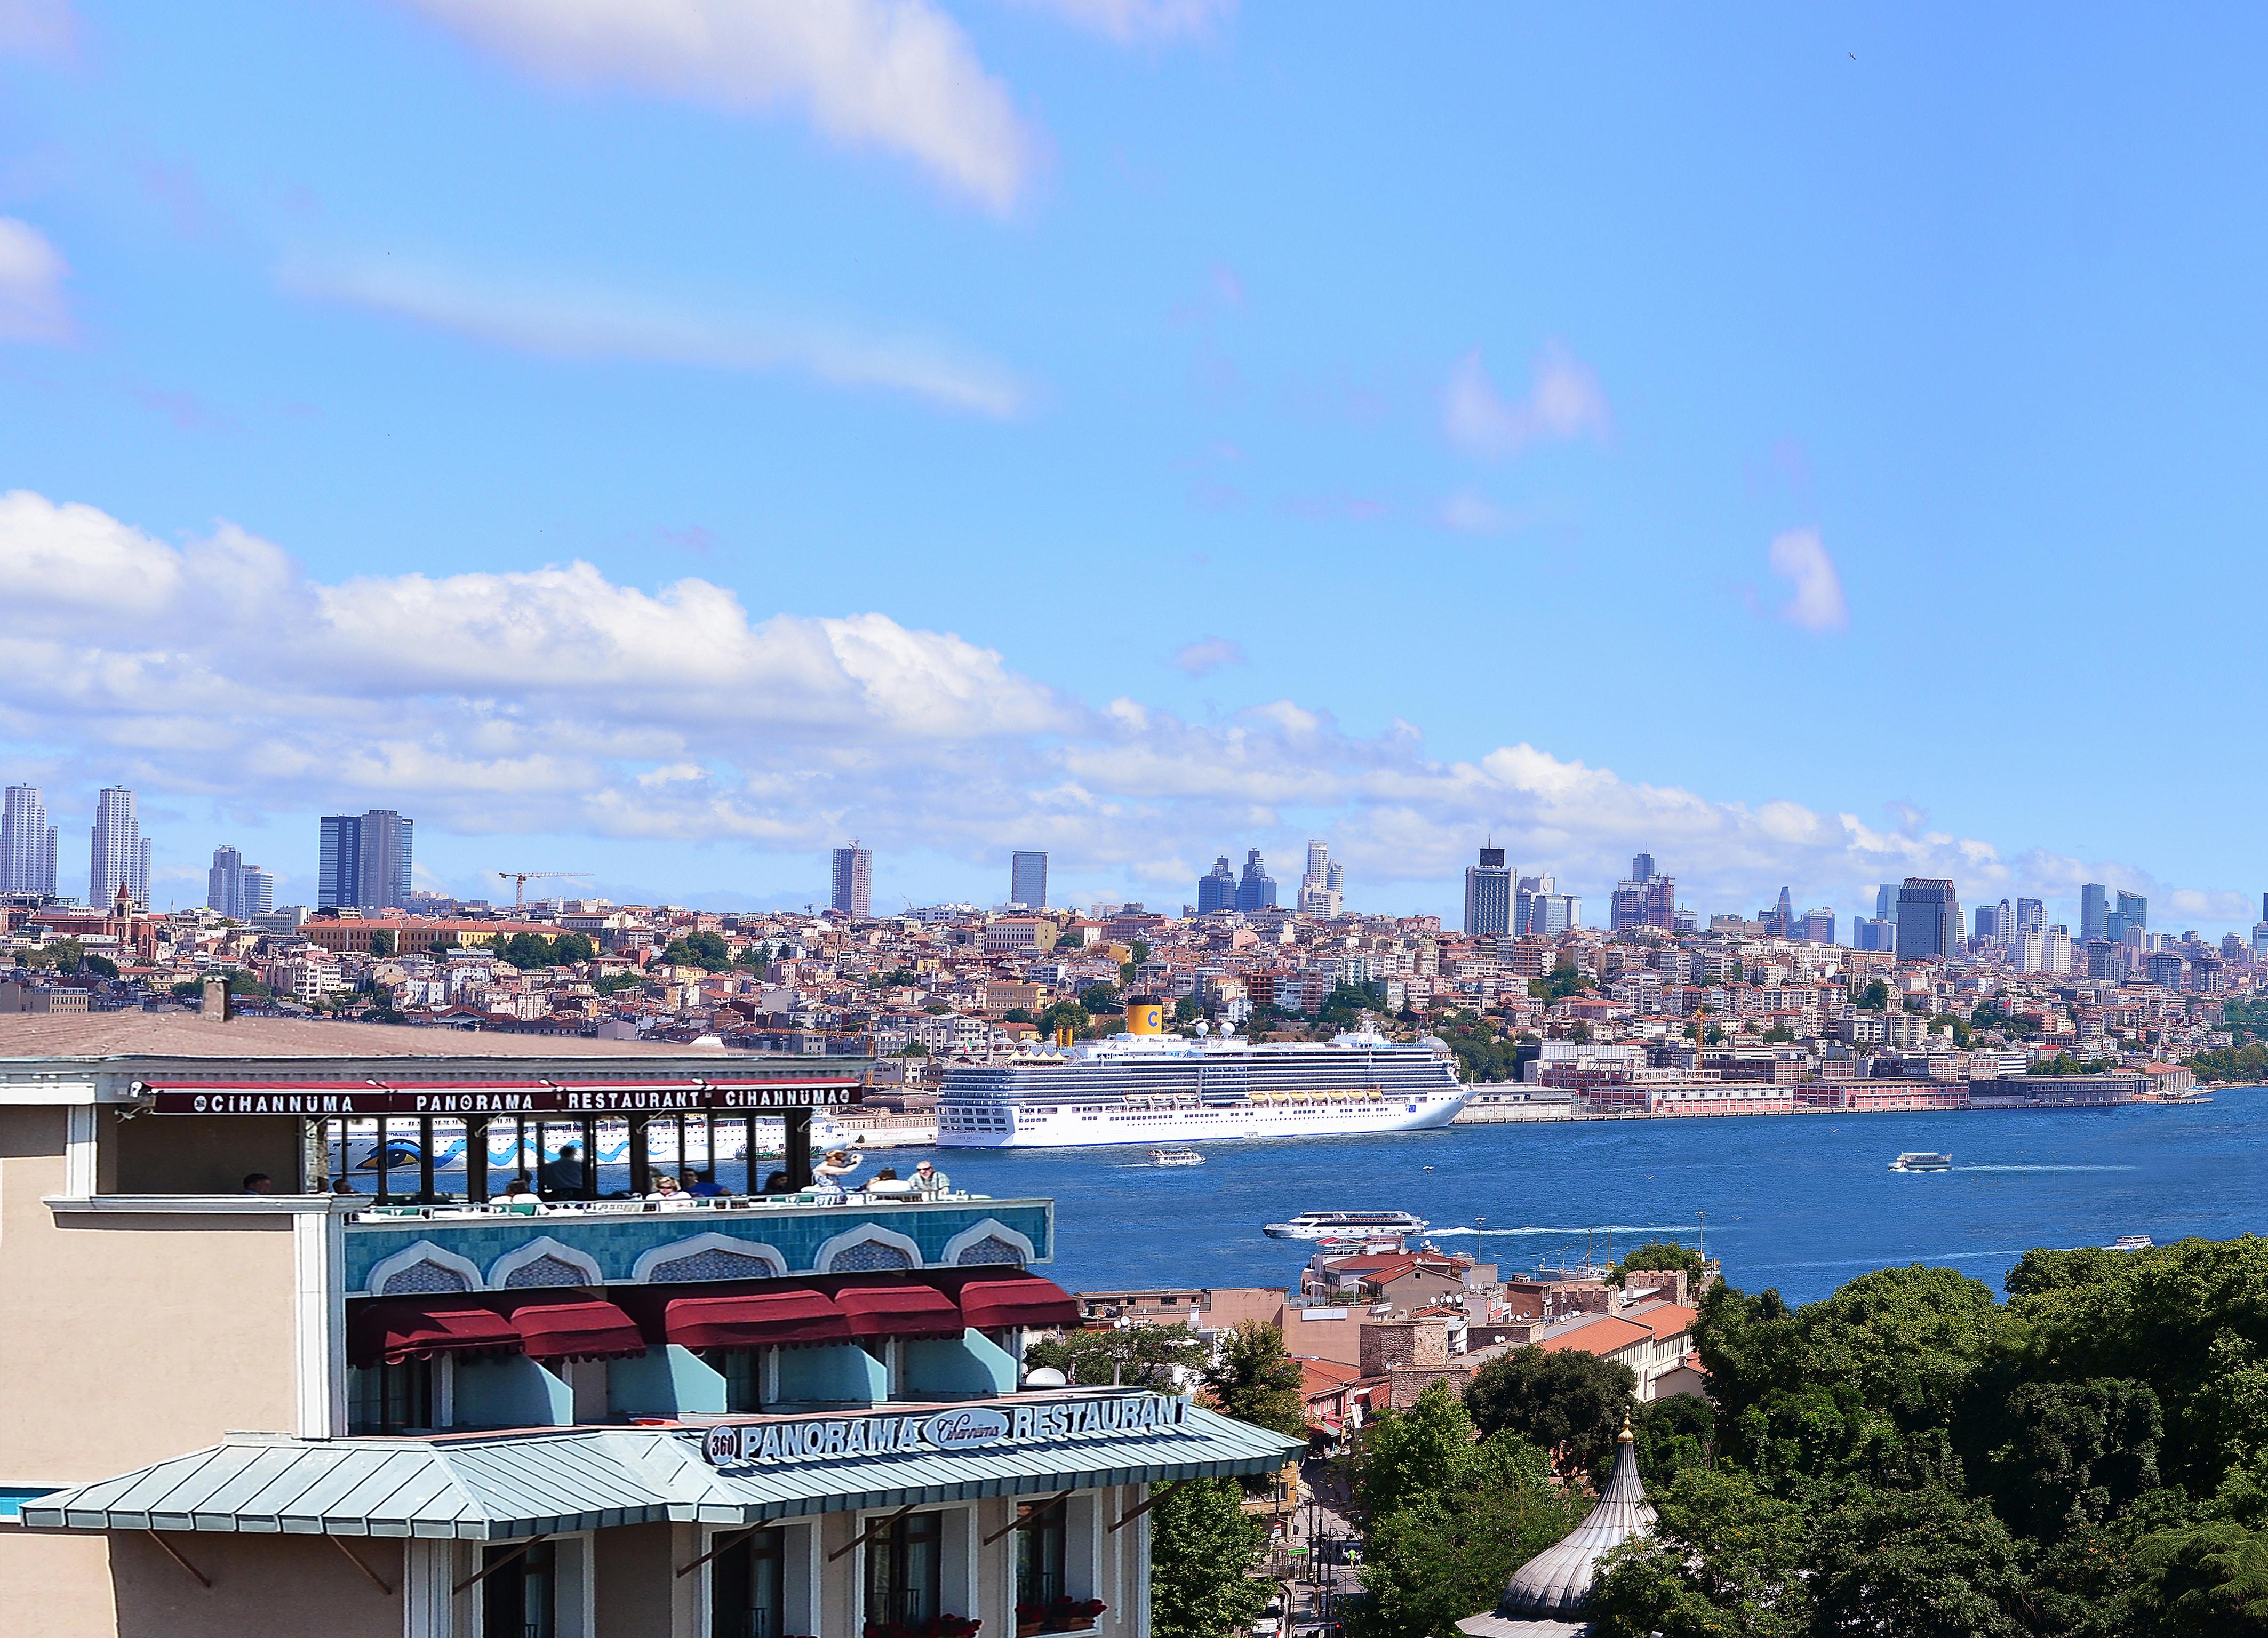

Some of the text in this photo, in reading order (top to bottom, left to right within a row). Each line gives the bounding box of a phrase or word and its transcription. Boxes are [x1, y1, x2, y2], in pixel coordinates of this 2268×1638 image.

[1148, 1011, 1158, 1027] C
[417, 1094, 532, 1111] PANORAMA
[568, 1092, 698, 1108] RESTAURANT
[712, 1435, 734, 1456] 360
[740, 1417, 917, 1459] PANORAMA
[1013, 1395, 1193, 1439] RESTAURANT
